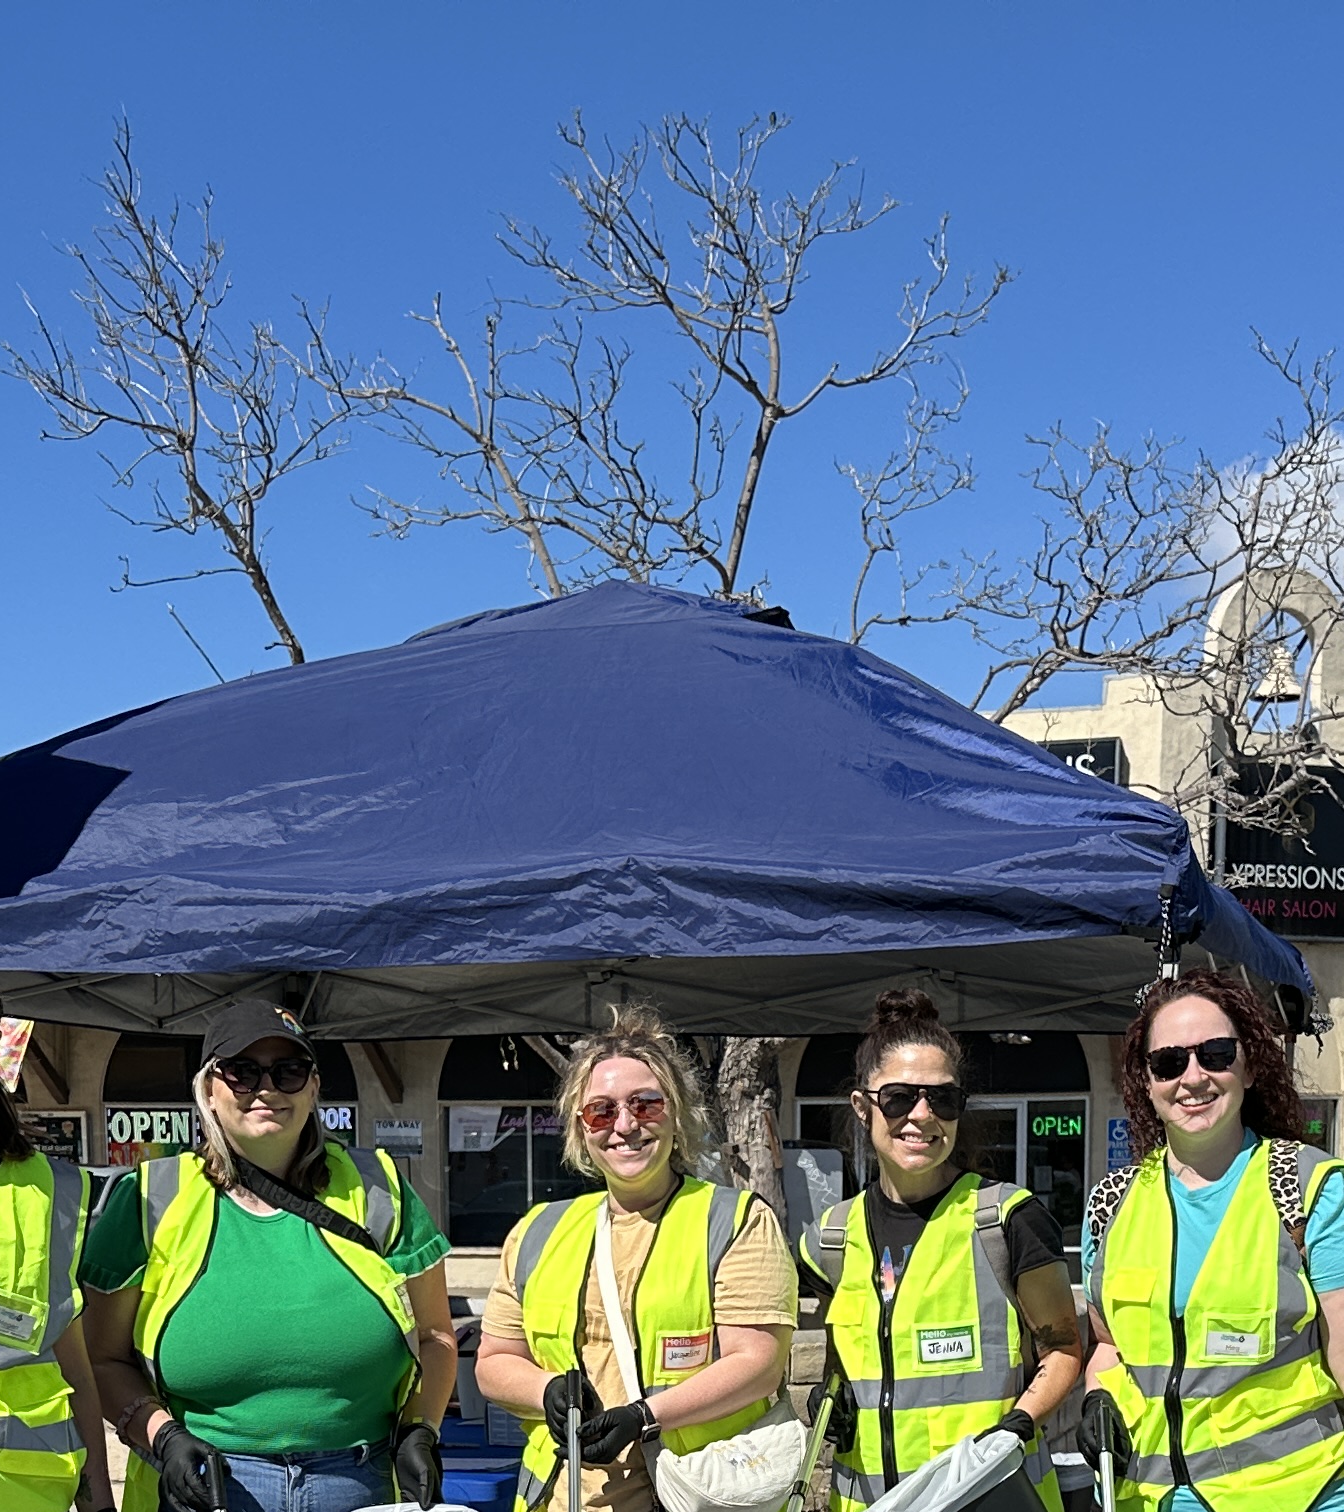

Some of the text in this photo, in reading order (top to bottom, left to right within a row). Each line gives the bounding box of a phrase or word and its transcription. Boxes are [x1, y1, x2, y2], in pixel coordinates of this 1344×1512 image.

[1239, 898, 1337, 919] HAIR SALON
[110, 1110, 190, 1144] OPEN
[376, 1119, 420, 1129] TOW AWAY
[1032, 1115, 1082, 1136] OPEN
[665, 1337, 692, 1346] Hello
[920, 1330, 947, 1339] Hello
[927, 1340, 964, 1354] JENNA
